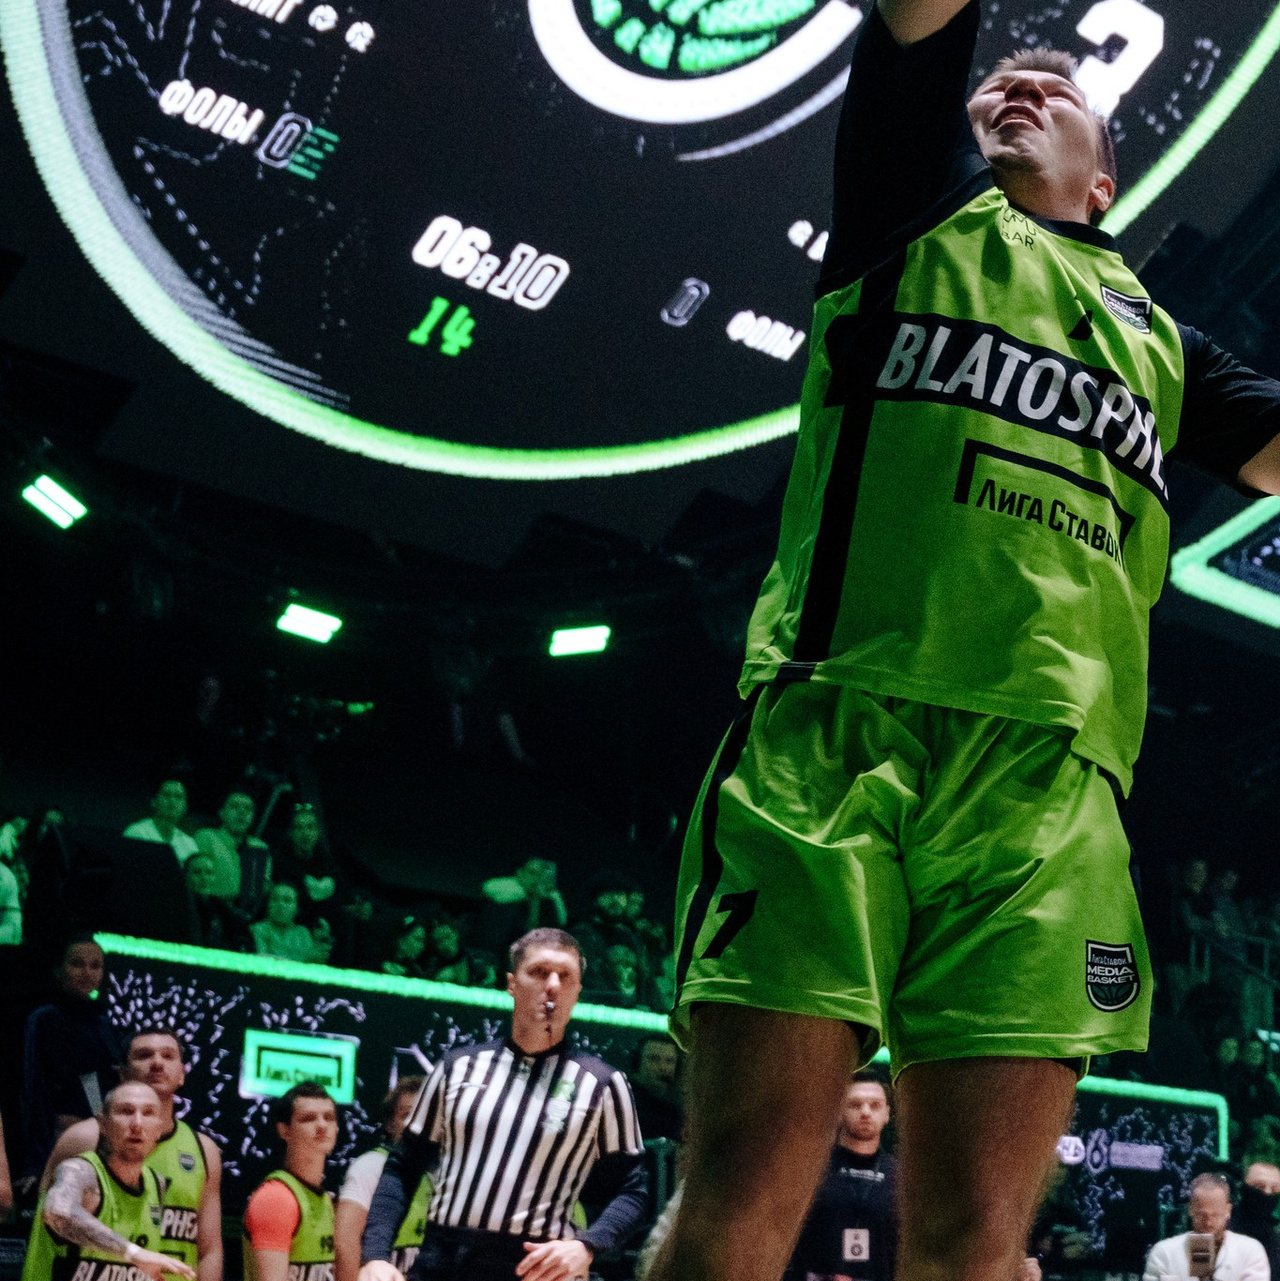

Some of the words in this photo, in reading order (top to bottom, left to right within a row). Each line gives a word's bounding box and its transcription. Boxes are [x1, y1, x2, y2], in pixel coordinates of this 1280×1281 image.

[158, 78, 265, 146] ФОЛЫ
[408, 295, 477, 357] 14
[726, 308, 806, 362] ФОЛЫ
[1087, 964, 1134, 977] MEDIA
[1087, 973, 1136, 984] BASKET
